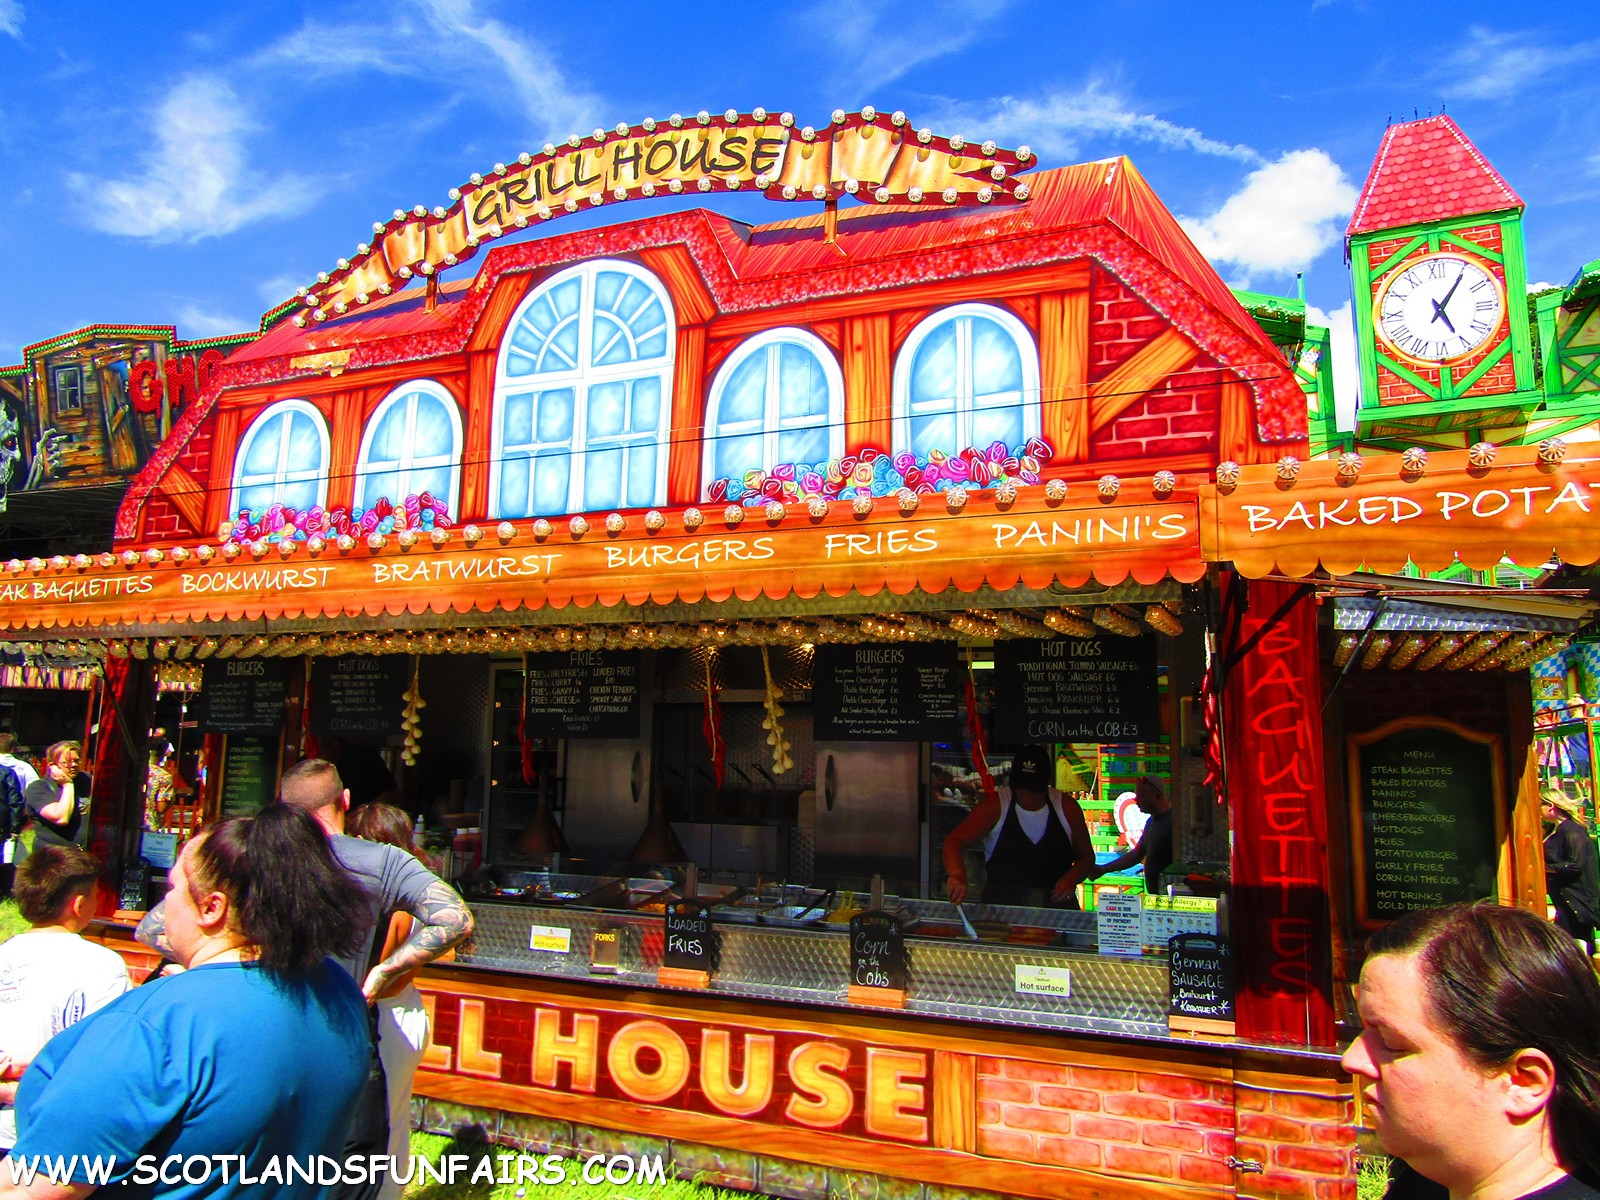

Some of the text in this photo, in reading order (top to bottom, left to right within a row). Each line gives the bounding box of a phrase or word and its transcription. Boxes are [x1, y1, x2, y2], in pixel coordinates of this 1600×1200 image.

[472, 136, 784, 226] GRILL HOUSE
[129, 346, 240, 418] GHO
[1241, 481, 1600, 532] BAKED POTA
[0, 513, 1188, 602] AK BAGUETTES BOCKWURST BRATWURST BURGERS FRIES PANINI'S
[1041, 641, 1102, 657] HOT DOGS
[570, 651, 603, 666] FRIES
[855, 649, 904, 663] BURGERS
[1017, 661, 1067, 672] TRADITIONAL
[1027, 672, 1045, 681] HOT
[1048, 672, 1064, 681] DOG
[1068, 672, 1102, 682] SAUSAGE
[1028, 720, 1065, 737] CORN
[1096, 722, 1121, 737] COB
[1122, 722, 1138, 736] £3
[1403, 750, 1435, 759] MENU
[1370, 766, 1453, 775] STEAK BAGUETTES
[1371, 779, 1447, 788] BAKED POTATOES
[1372, 789, 1417, 798] PANINI'S
[1372, 800, 1425, 810] BURGERS
[1372, 812, 1456, 823] CHEESEBURGERS
[1373, 825, 1424, 836] HOTDOGS
[1374, 837, 1405, 846] FRIES
[1374, 848, 1458, 860] POTATO WEDGES
[1375, 861, 1445, 872] CURLY FRIES
[1376, 873, 1460, 885] CORN ON THE COB
[1376, 890, 1442, 901] HOT DRINKS
[1377, 901, 1440, 911] COLD DRI
[668, 916, 707, 933] LOADED
[594, 933, 615, 942] FORKS
[854, 931, 890, 955] Corn
[668, 934, 703, 956] FRIES
[1172, 951, 1221, 970] German
[856, 964, 890, 987] Cobs
[1171, 970, 1224, 989] SAUSAGE
[1020, 982, 1064, 992] Hot surface
[532, 1007, 930, 1142] HOUSE
